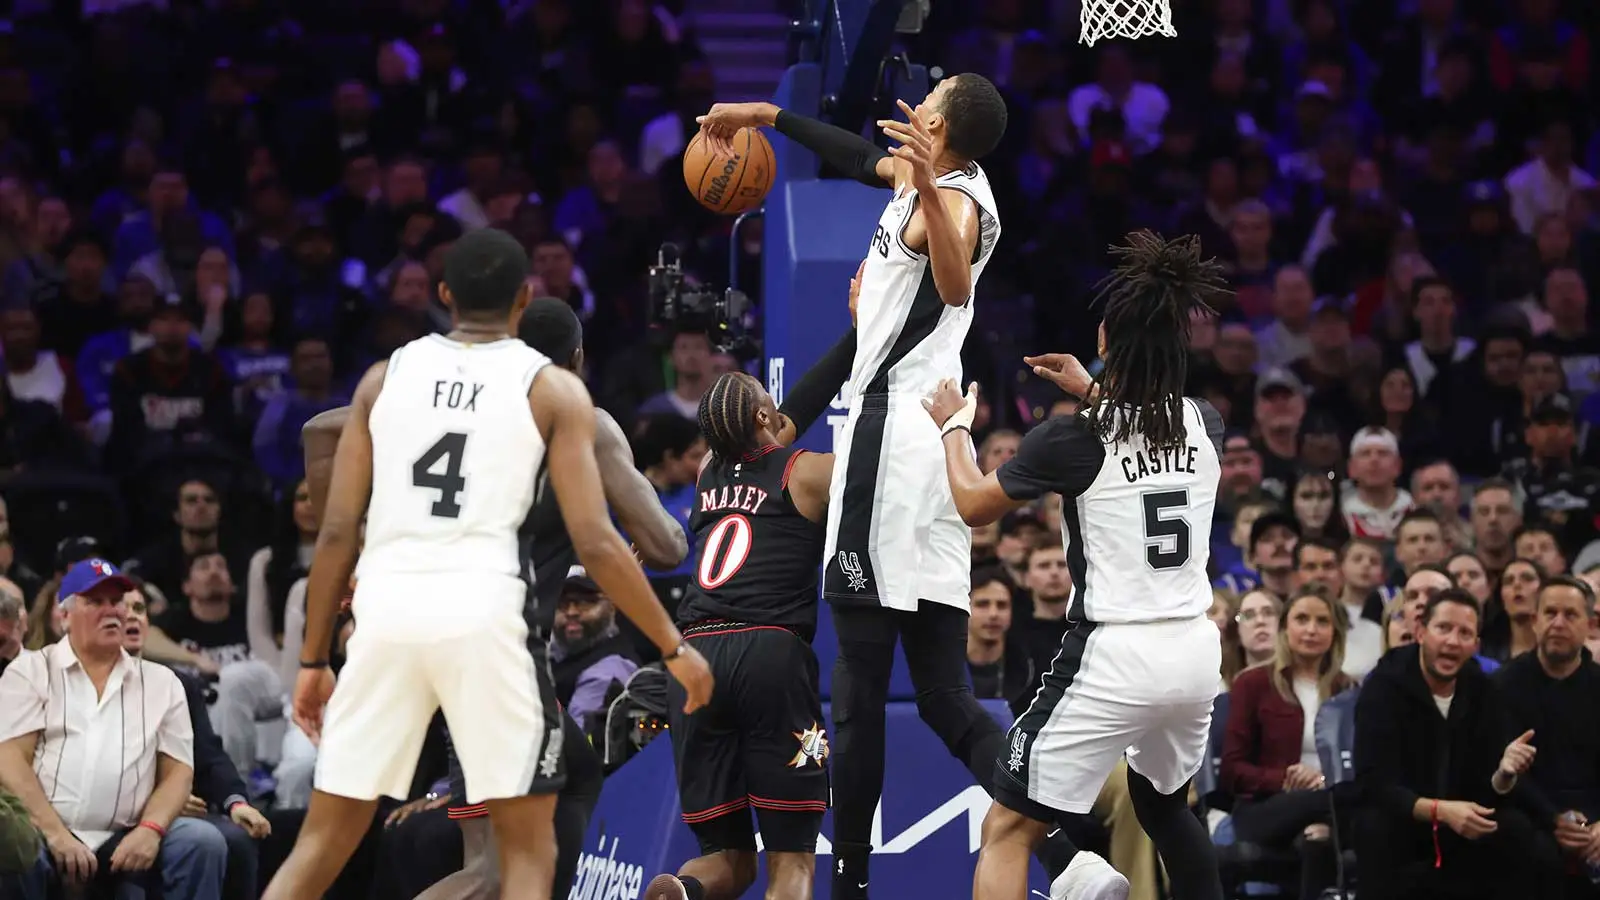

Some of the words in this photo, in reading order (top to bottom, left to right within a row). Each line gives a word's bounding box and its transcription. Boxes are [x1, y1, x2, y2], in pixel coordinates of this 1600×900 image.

[433, 380, 485, 412] FOX
[412, 431, 468, 519] 4
[1121, 445, 1198, 483] CASTLE
[700, 484, 768, 515] MAXEY
[698, 513, 753, 590] 0
[1140, 487, 1192, 572] 5
